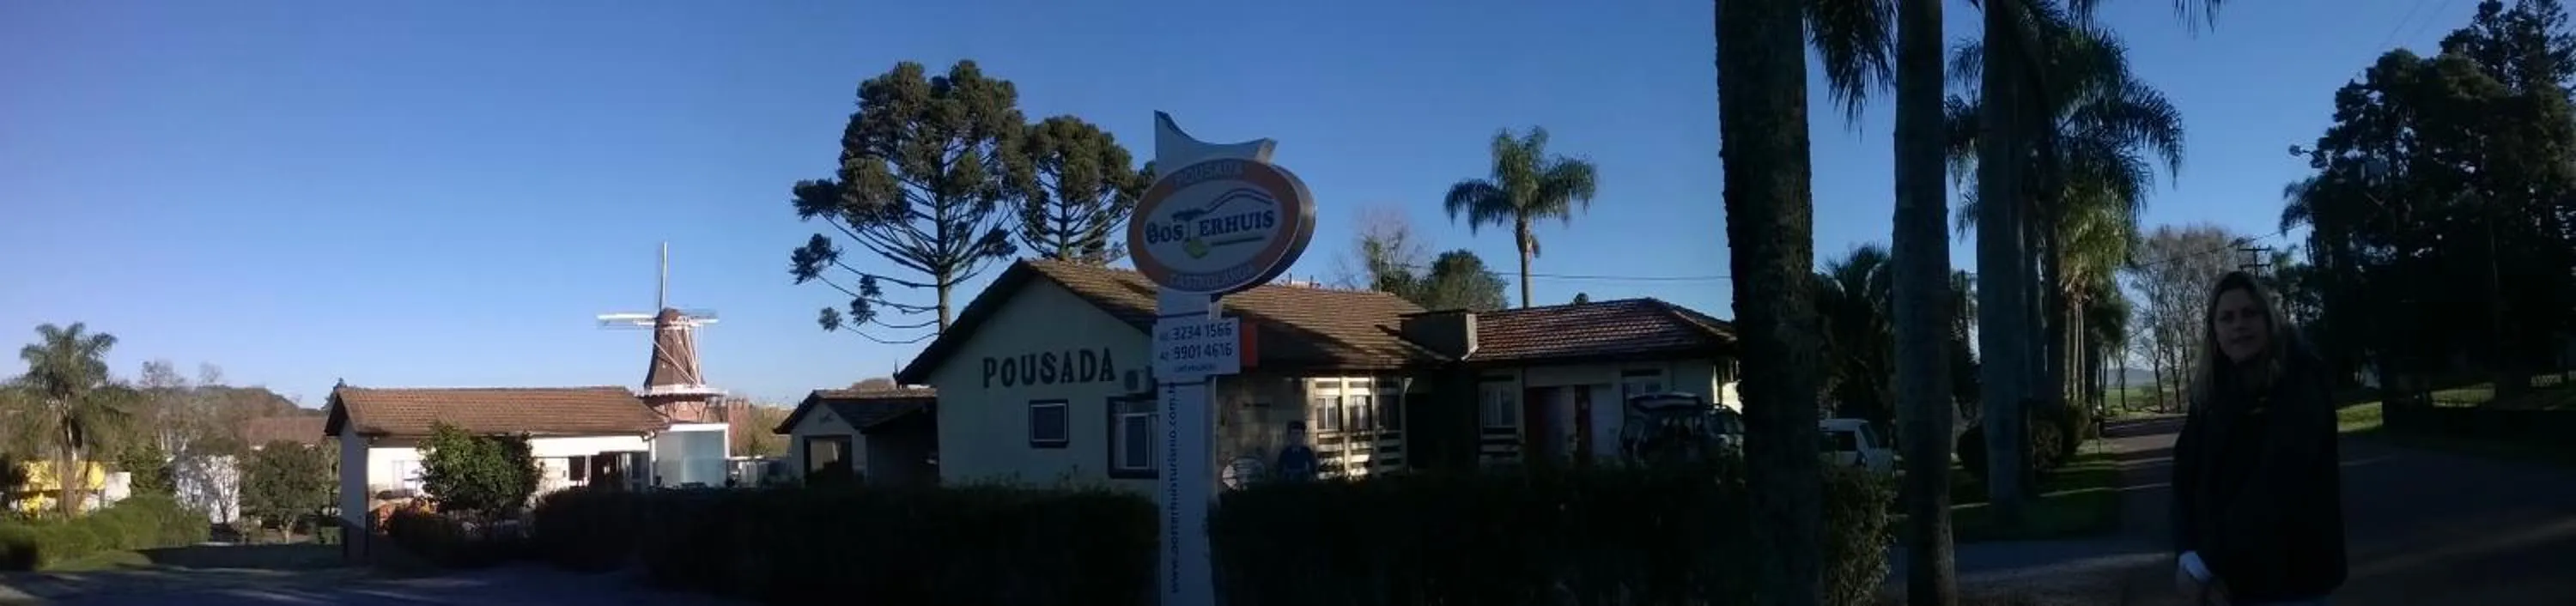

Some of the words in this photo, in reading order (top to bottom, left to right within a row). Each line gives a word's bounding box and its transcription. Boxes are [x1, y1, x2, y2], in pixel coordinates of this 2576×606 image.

[1172, 324, 1201, 341] 3234
[1206, 322, 1232, 337] 1566
[1174, 345, 1201, 360] 9901
[1204, 342, 1233, 358] 4616
[981, 347, 1117, 389] POUSADA
